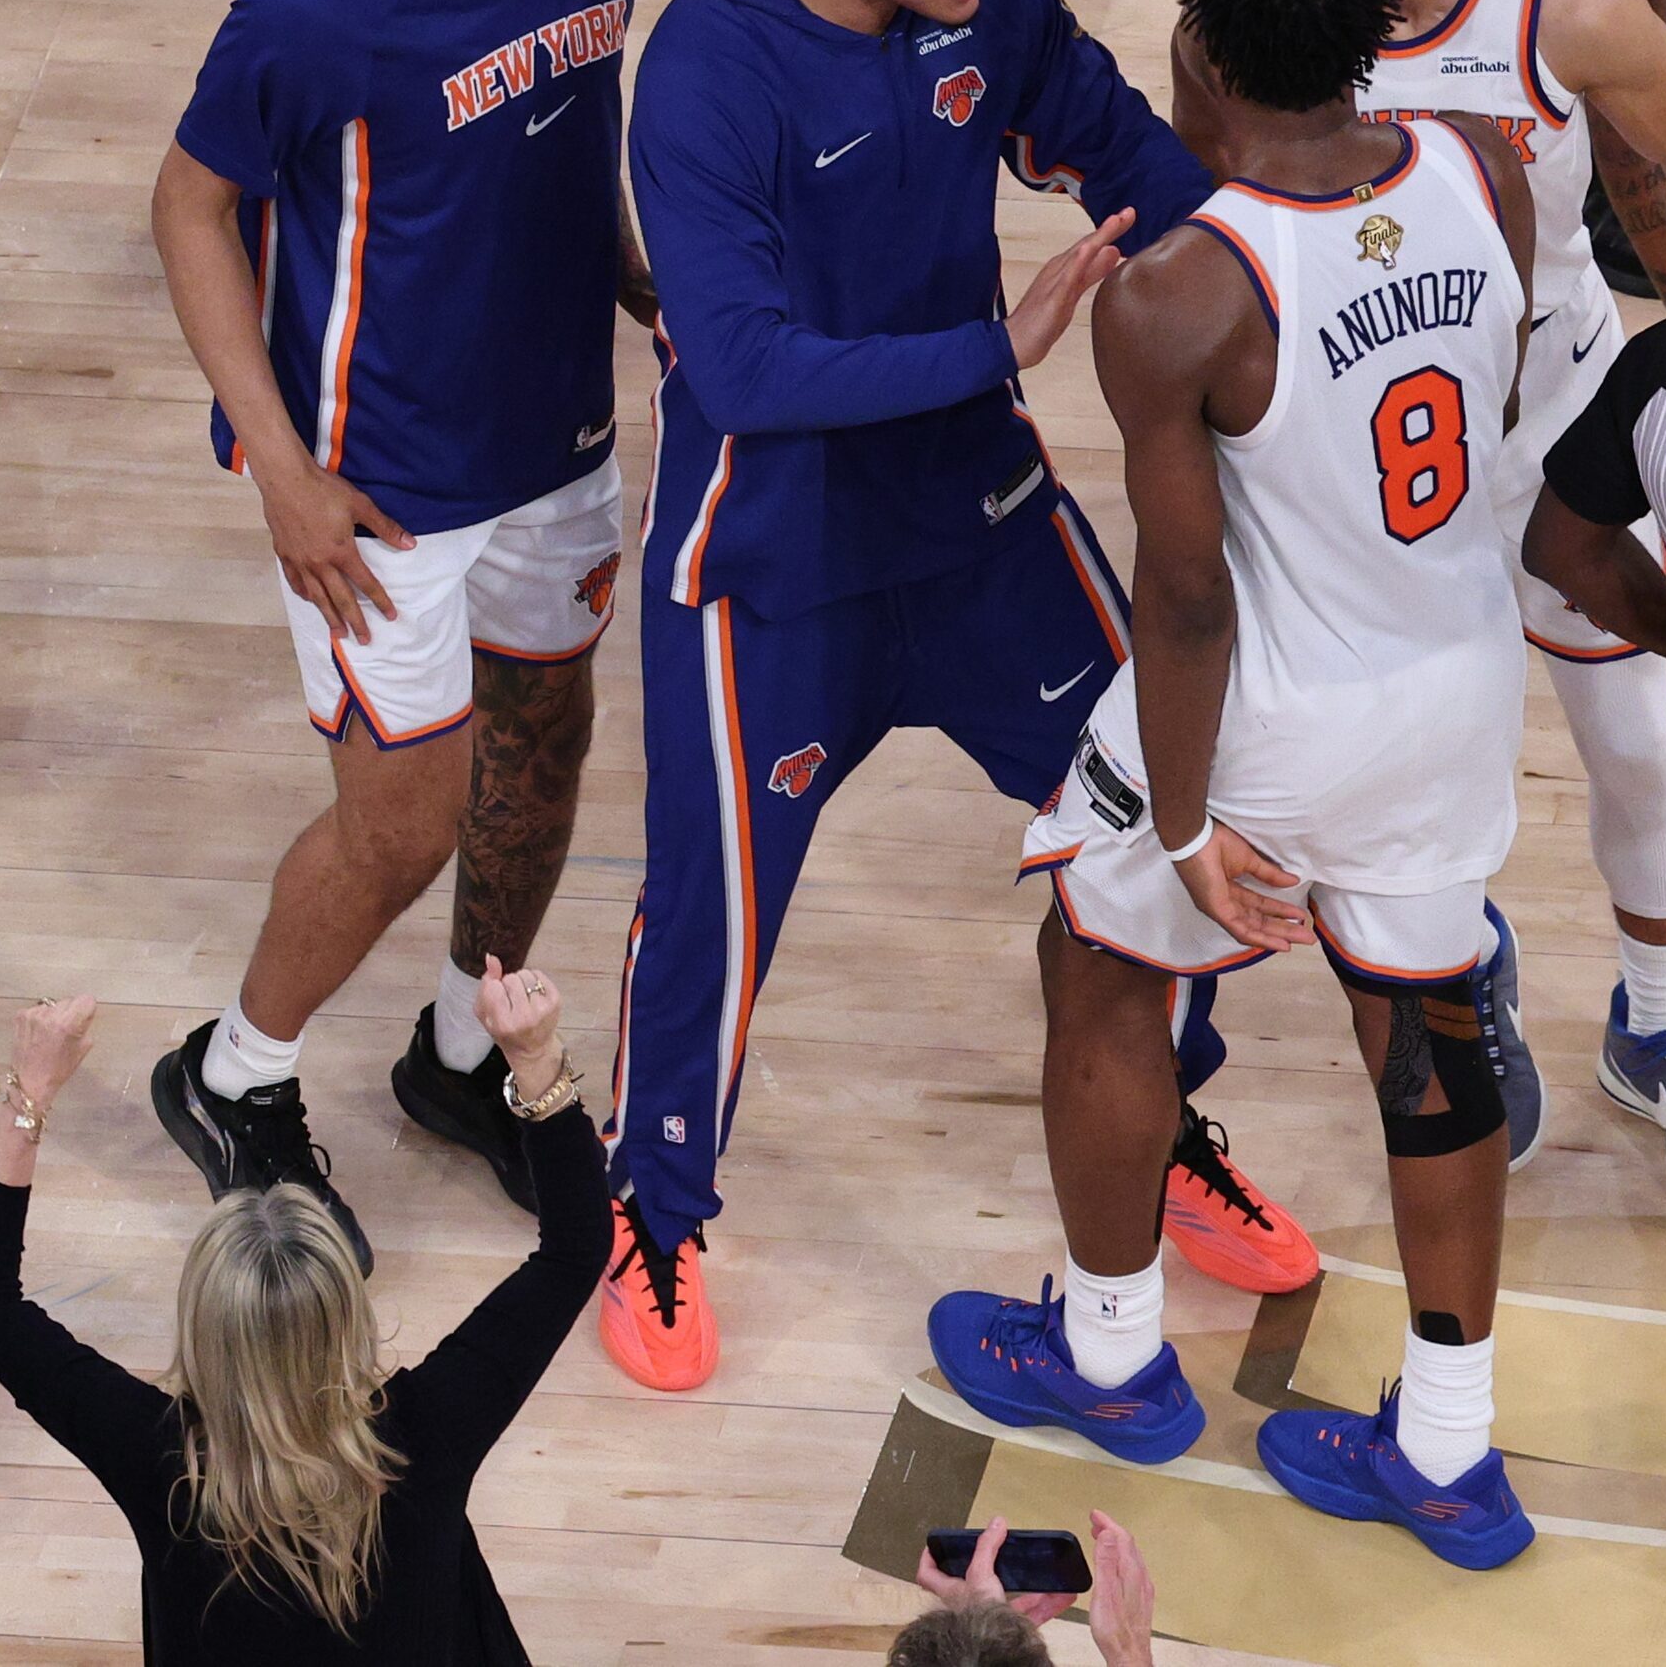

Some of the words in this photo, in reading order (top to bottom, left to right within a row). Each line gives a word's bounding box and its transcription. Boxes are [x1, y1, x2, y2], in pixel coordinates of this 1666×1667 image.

[919, 40, 940, 56] abu
[939, 25, 973, 47] dhabi
[1441, 63, 1468, 74] abu
[1469, 61, 1511, 73] dhabi
[442, 31, 536, 132] NEW
[1357, 217, 1404, 260] Finals
[1318, 268, 1487, 380] ANUNOBY
[1370, 363, 1469, 546] 8
